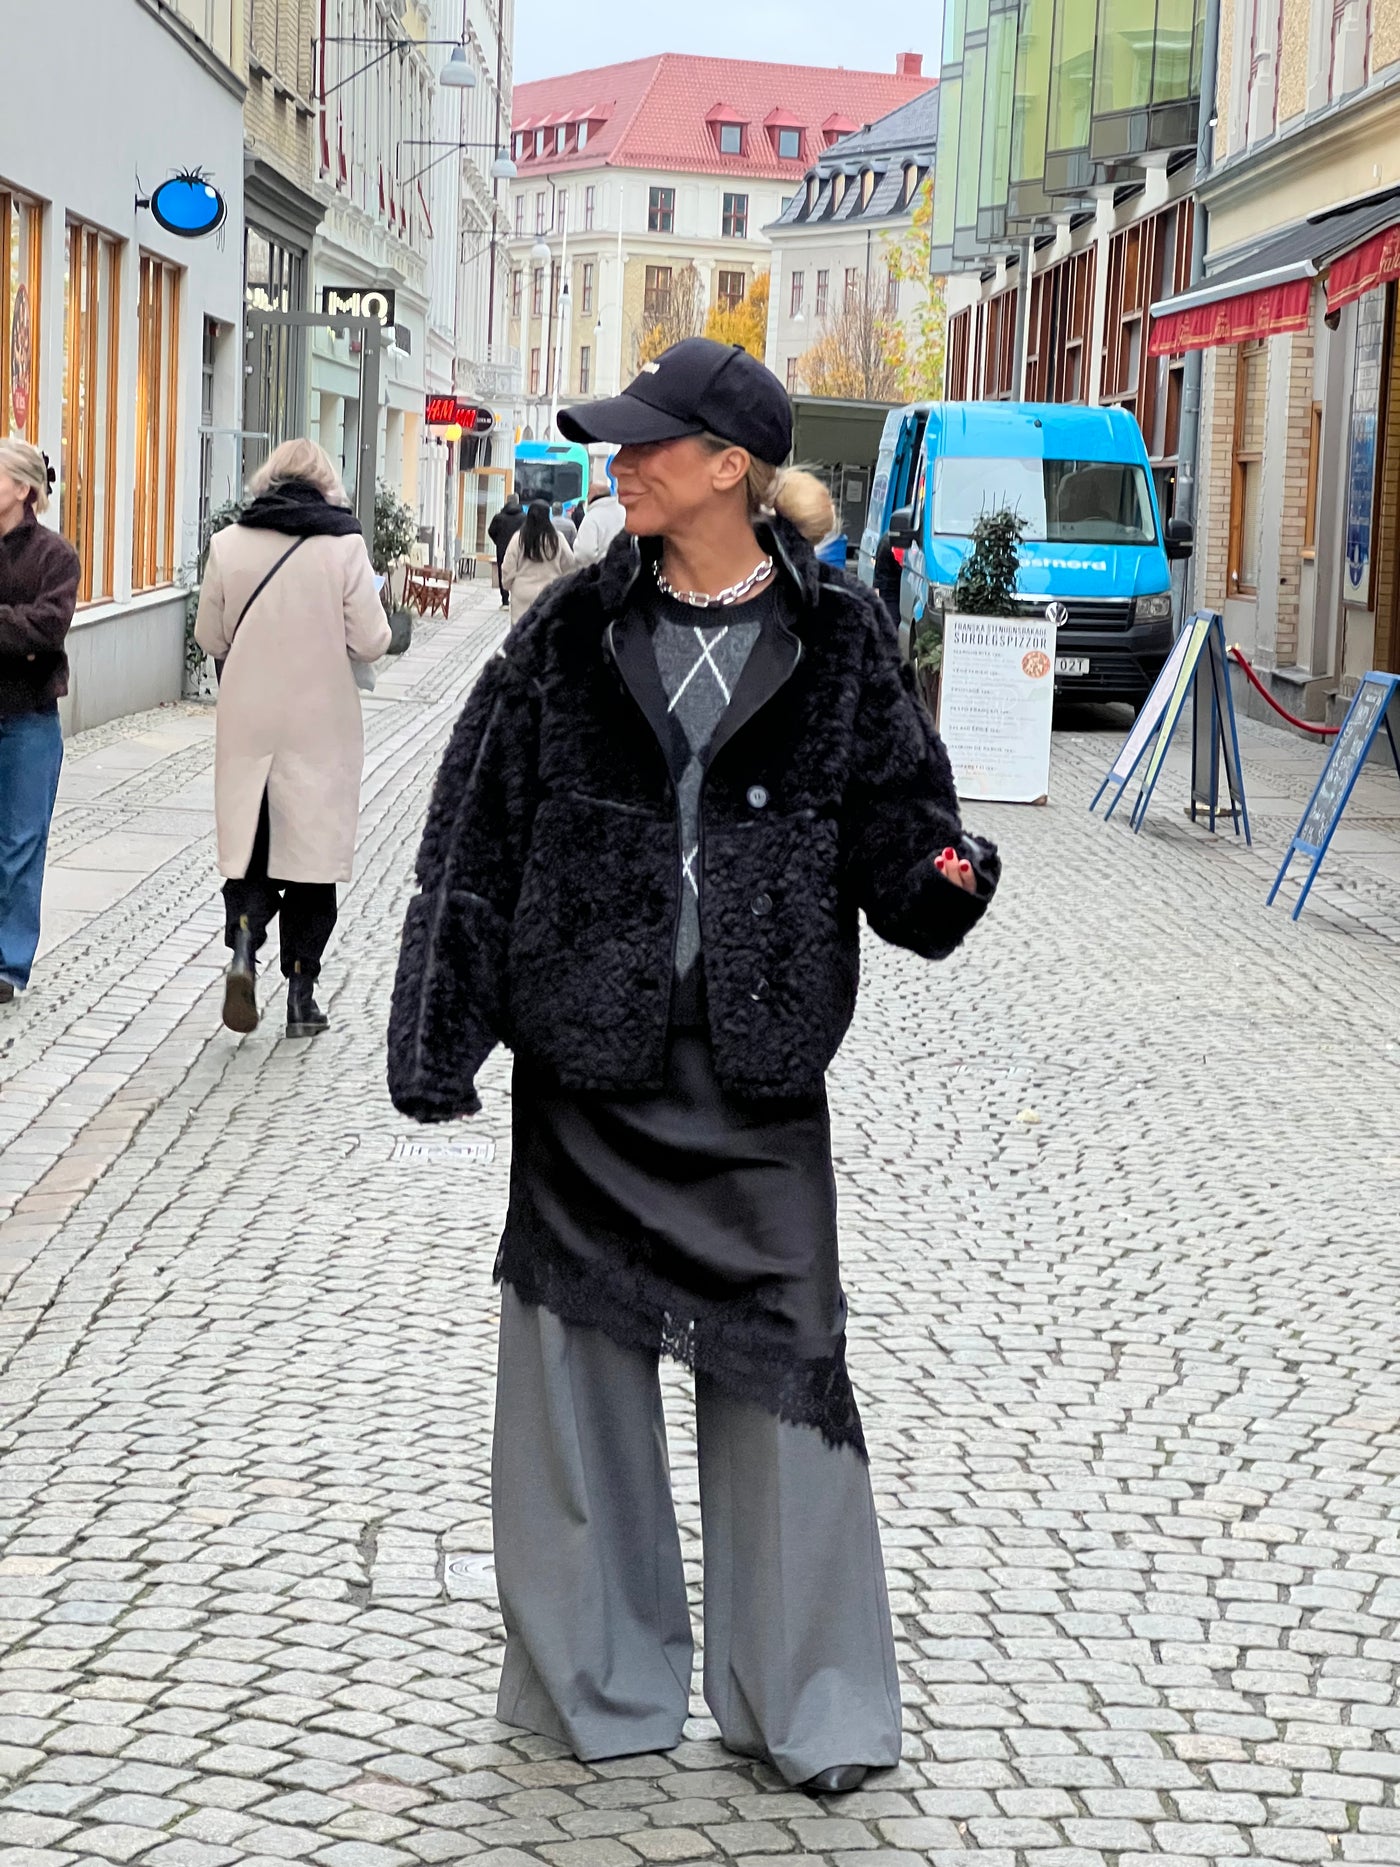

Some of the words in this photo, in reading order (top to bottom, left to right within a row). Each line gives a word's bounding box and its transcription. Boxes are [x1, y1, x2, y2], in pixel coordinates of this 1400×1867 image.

[328, 291, 388, 326] MQ
[1018, 557, 1107, 571] ostnord
[954, 632, 1047, 649] SURDEGSPIZZOR
